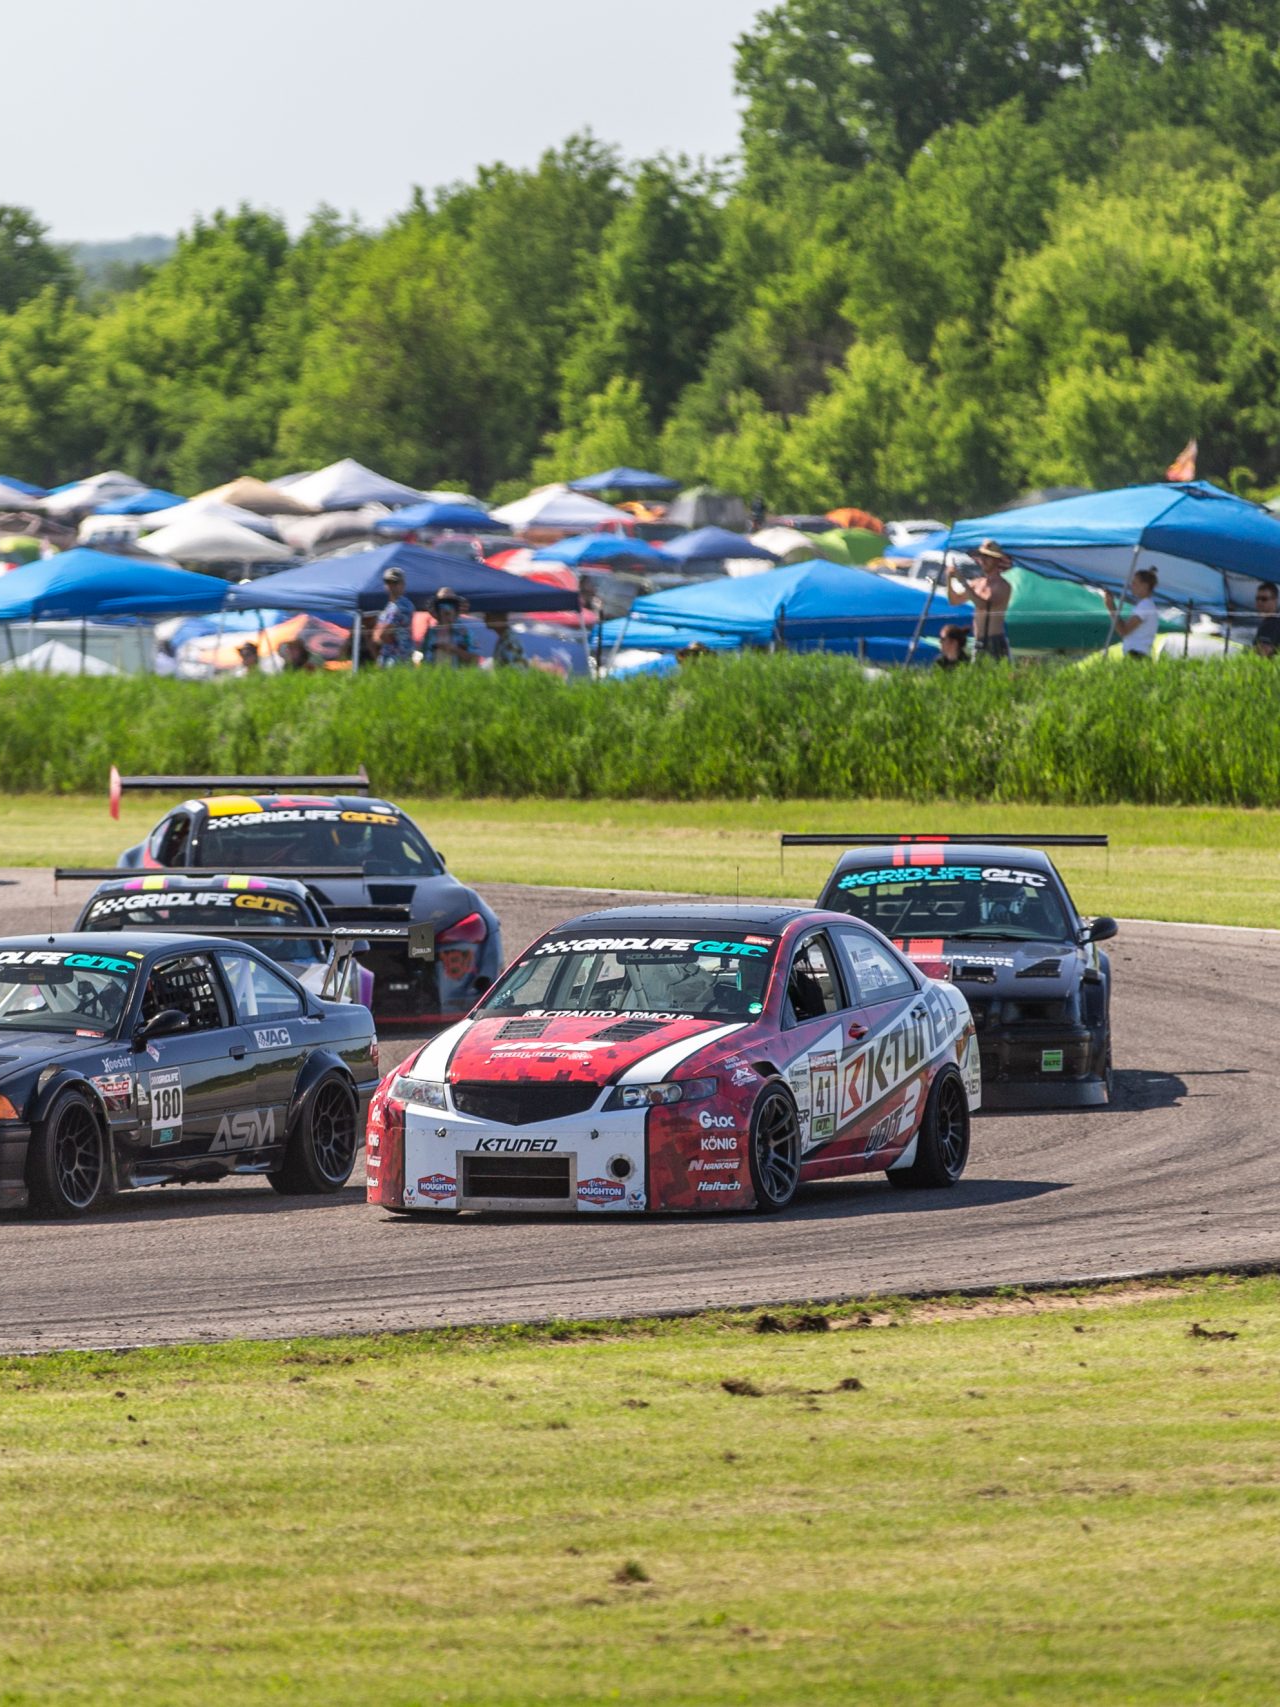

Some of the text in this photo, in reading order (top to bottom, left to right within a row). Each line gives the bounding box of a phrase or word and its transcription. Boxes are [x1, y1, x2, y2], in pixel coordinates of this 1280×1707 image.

[239, 810, 399, 825] GRIDLIFE GLTC
[981, 868, 1047, 887] GLTC
[124, 893, 299, 916] GRIDLIFE GLTC
[572, 938, 703, 951] GRIDLIFE
[693, 940, 769, 957] GLTC
[64, 954, 136, 973] GLTC
[617, 1011, 695, 1021] ARMOUR
[102, 1056, 132, 1073] Hoosier
[815, 1075, 831, 1114] 41
[154, 1088, 181, 1121] 180
[208, 1107, 276, 1152] ASM
[475, 1138, 558, 1152] K-TUNED
[701, 1136, 738, 1151] KÖNIG
[420, 1183, 457, 1192] HOUGHTON
[697, 1181, 741, 1191] Haltech
